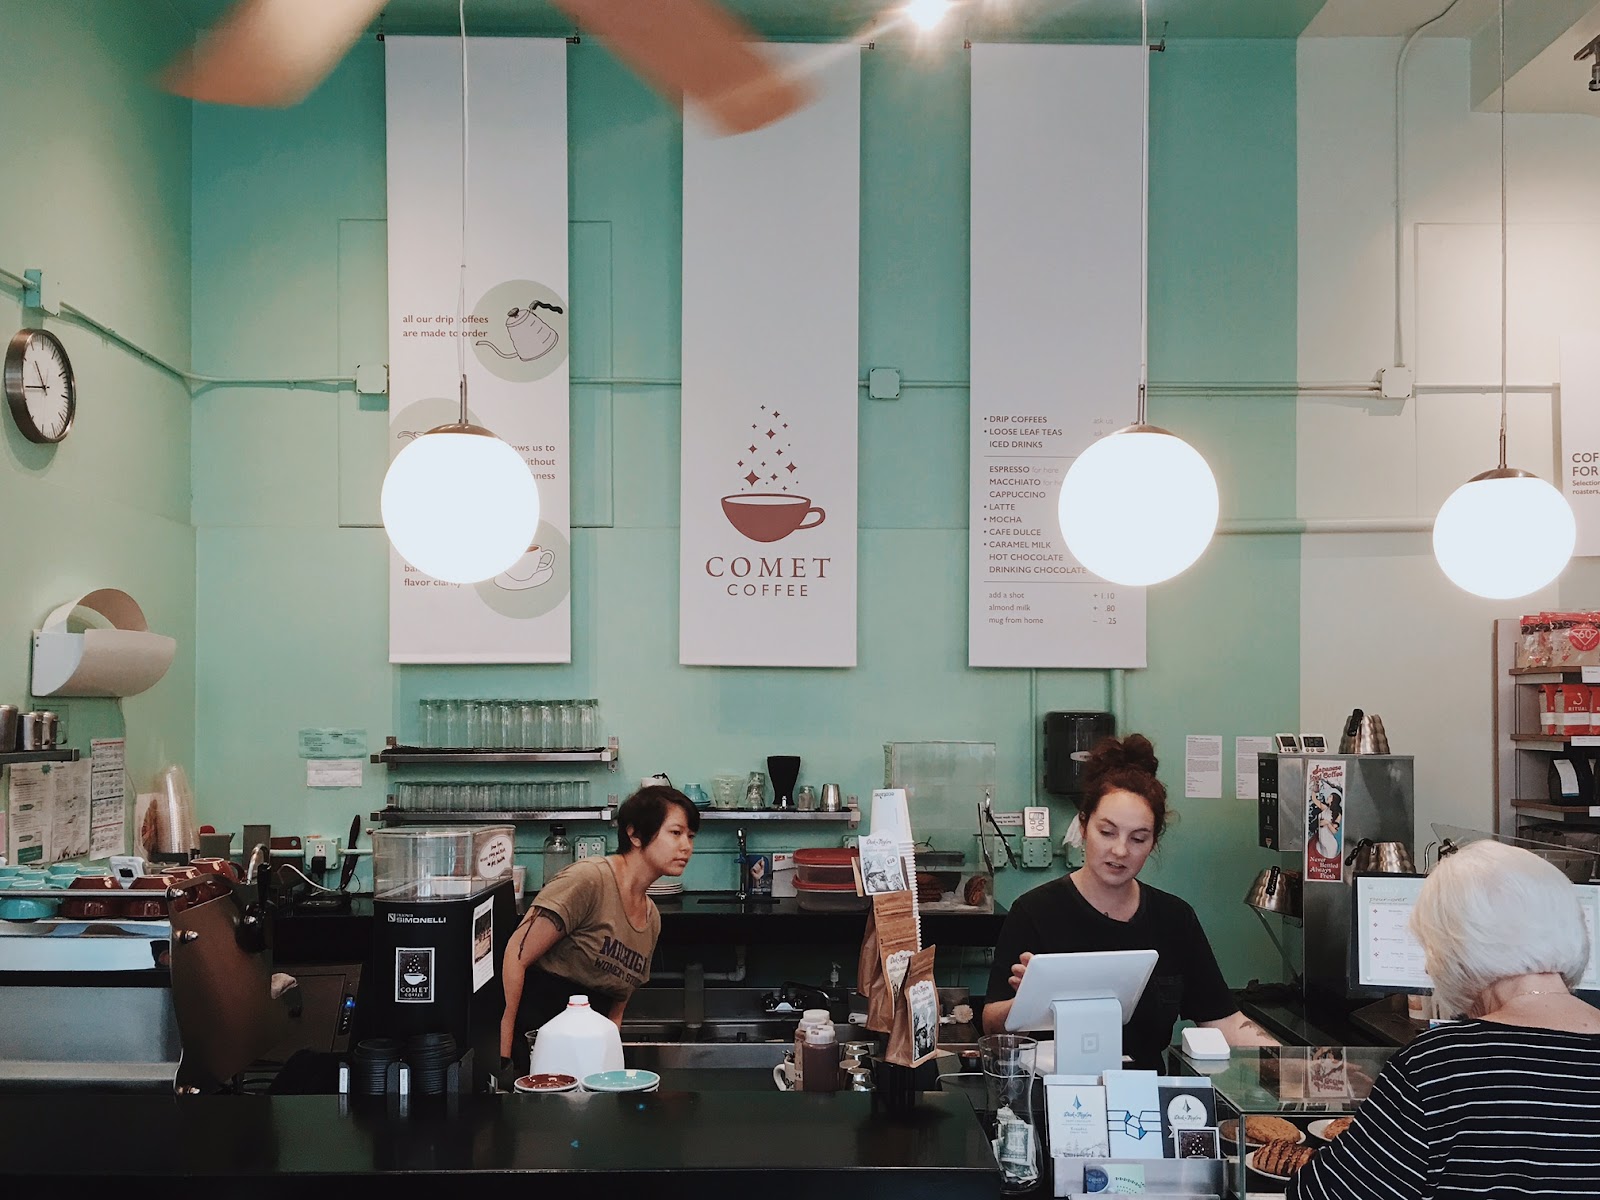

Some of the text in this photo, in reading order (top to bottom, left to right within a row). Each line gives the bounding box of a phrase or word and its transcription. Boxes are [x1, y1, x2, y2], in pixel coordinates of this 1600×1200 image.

[402, 315, 413, 323] all
[435, 315, 454, 325] drip
[458, 315, 489, 323] offees
[420, 329, 446, 337] made
[461, 329, 488, 337] order
[1011, 416, 1048, 424] COFFEES
[989, 428, 1063, 437] LOOSE LEAF TEAS
[1011, 441, 1043, 449] DRINKS
[989, 491, 1046, 499] CAPPUCCINO
[1031, 541, 1052, 549] MILK
[989, 553, 1008, 561] HOT
[705, 556, 831, 578] COMET
[1033, 566, 1087, 574] CHOCOLATE
[404, 578, 431, 586] flavor
[727, 583, 808, 597] COFFEE
[1005, 616, 1022, 624] from
[1023, 616, 1043, 624] home
[1322, 771, 1343, 779] Coffee
